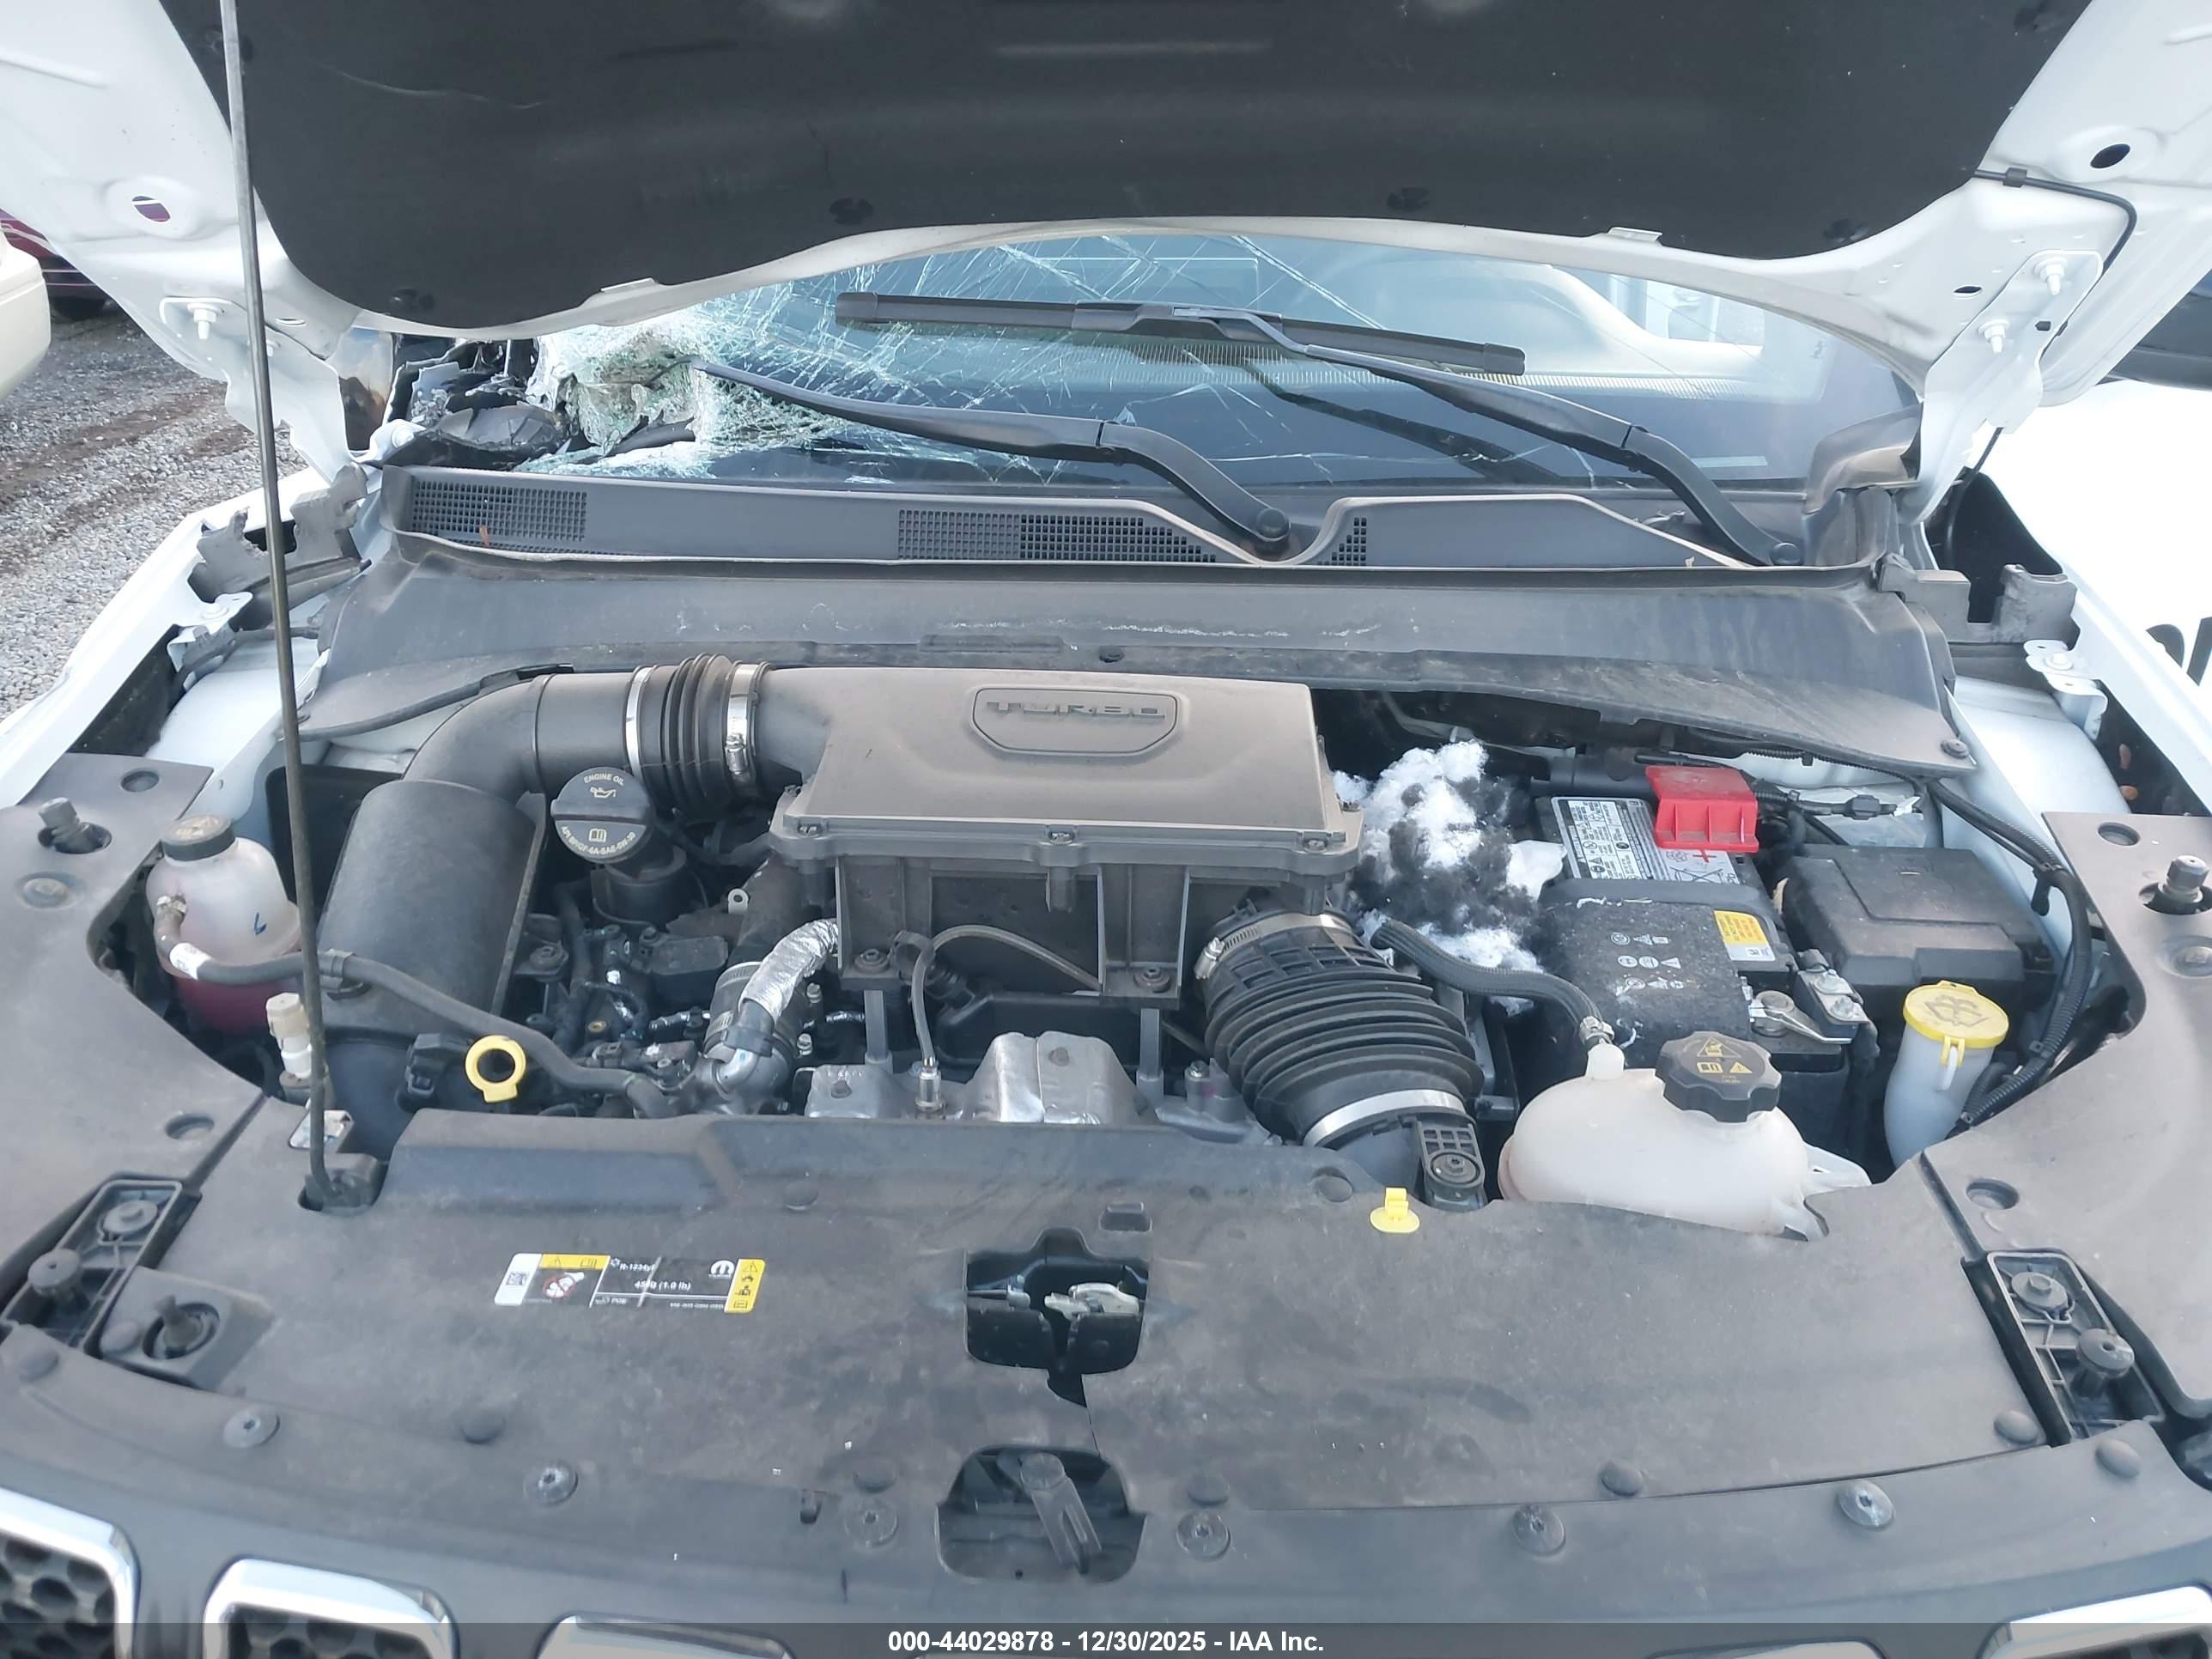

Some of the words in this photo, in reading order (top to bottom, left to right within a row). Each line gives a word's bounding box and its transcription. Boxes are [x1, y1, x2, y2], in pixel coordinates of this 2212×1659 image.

[986, 696, 1166, 720] TURBO
[584, 773, 612, 784] ENGINE
[612, 775, 625, 787] OIL
